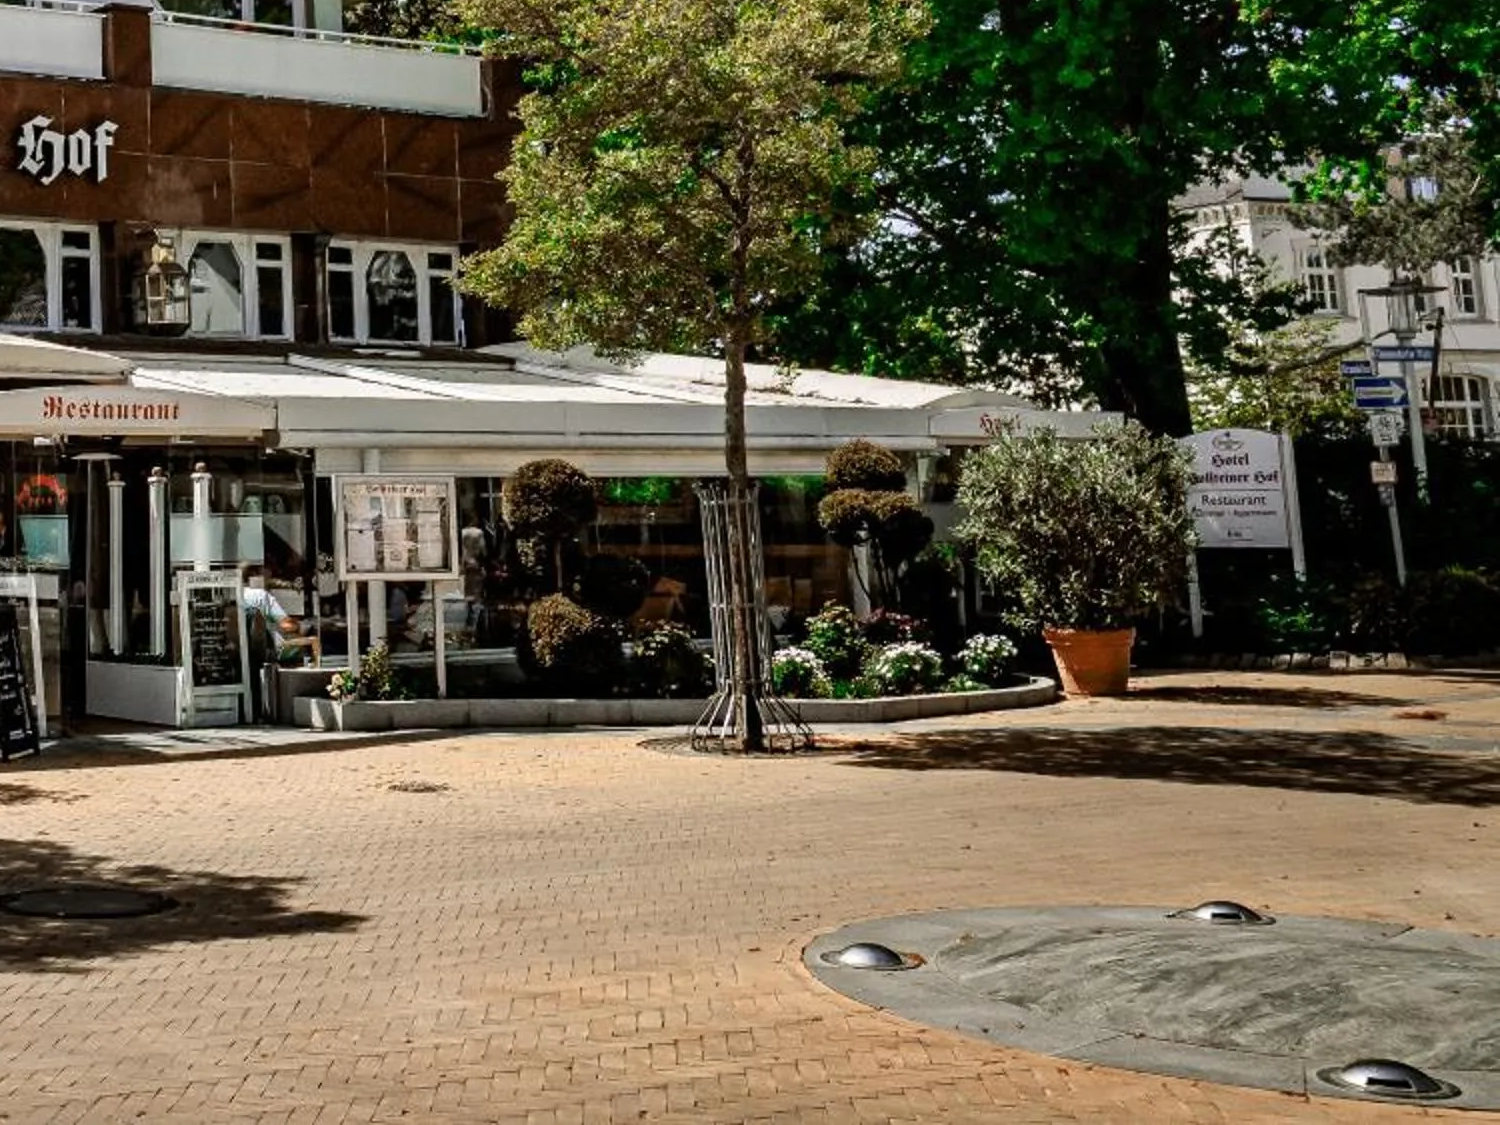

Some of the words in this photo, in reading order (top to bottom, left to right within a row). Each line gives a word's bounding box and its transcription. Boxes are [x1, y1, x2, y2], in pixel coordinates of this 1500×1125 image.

[17, 115, 120, 186] Hof
[43, 395, 180, 420] Restaurant
[1212, 453, 1250, 467] Hotel
[1201, 494, 1268, 506] Restaurant
